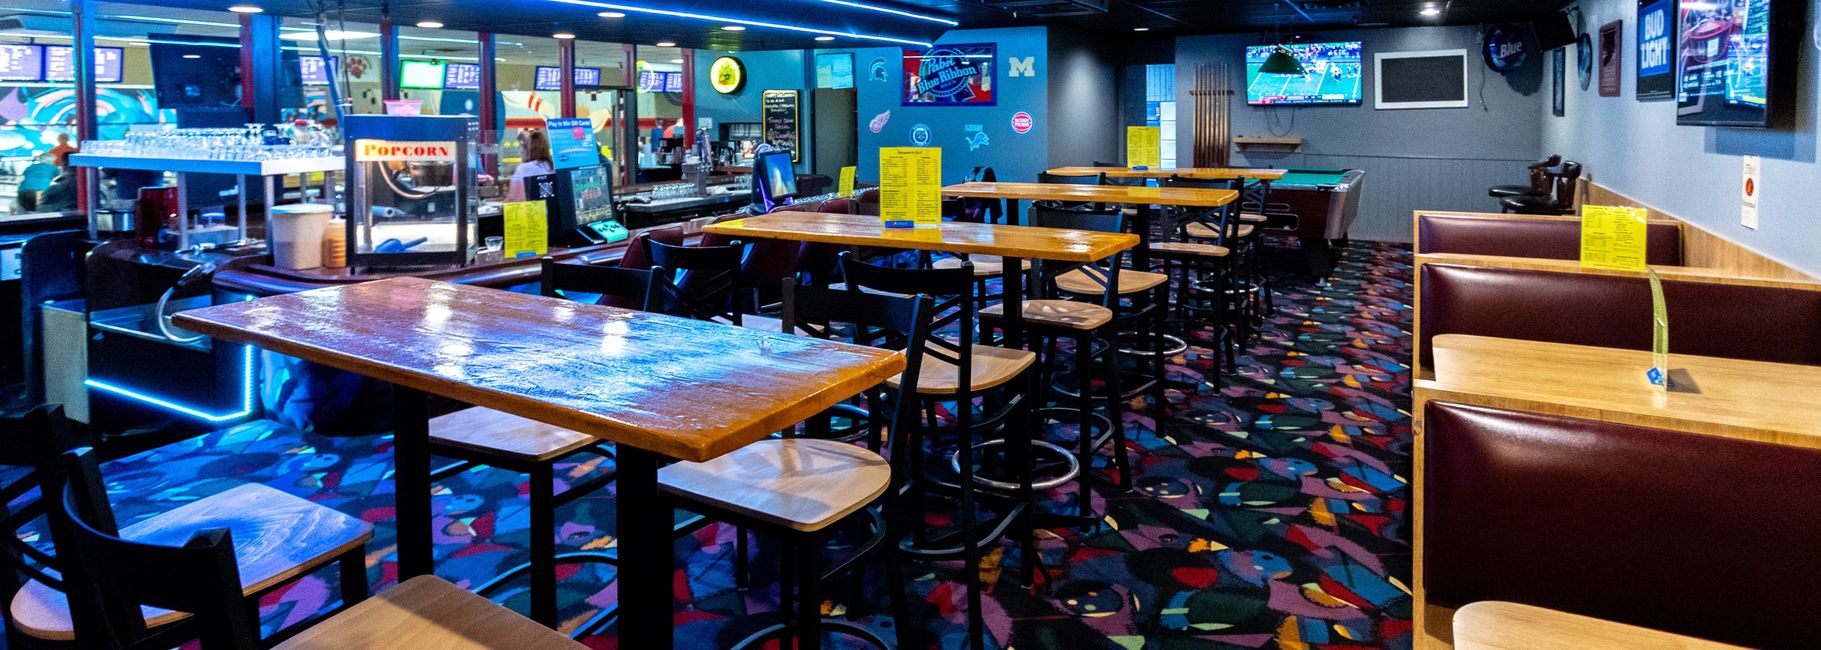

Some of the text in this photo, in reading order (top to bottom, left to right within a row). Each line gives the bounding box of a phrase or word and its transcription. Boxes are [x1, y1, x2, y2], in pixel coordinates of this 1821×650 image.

[1644, 9, 1665, 41] BUD
[1500, 41, 1523, 59] Blue
[1641, 36, 1668, 69] LIGHT
[928, 53, 956, 75] Pabst
[1008, 56, 1035, 77] M
[917, 65, 978, 94] Blue Ribbon
[364, 144, 449, 156] POPCORN
